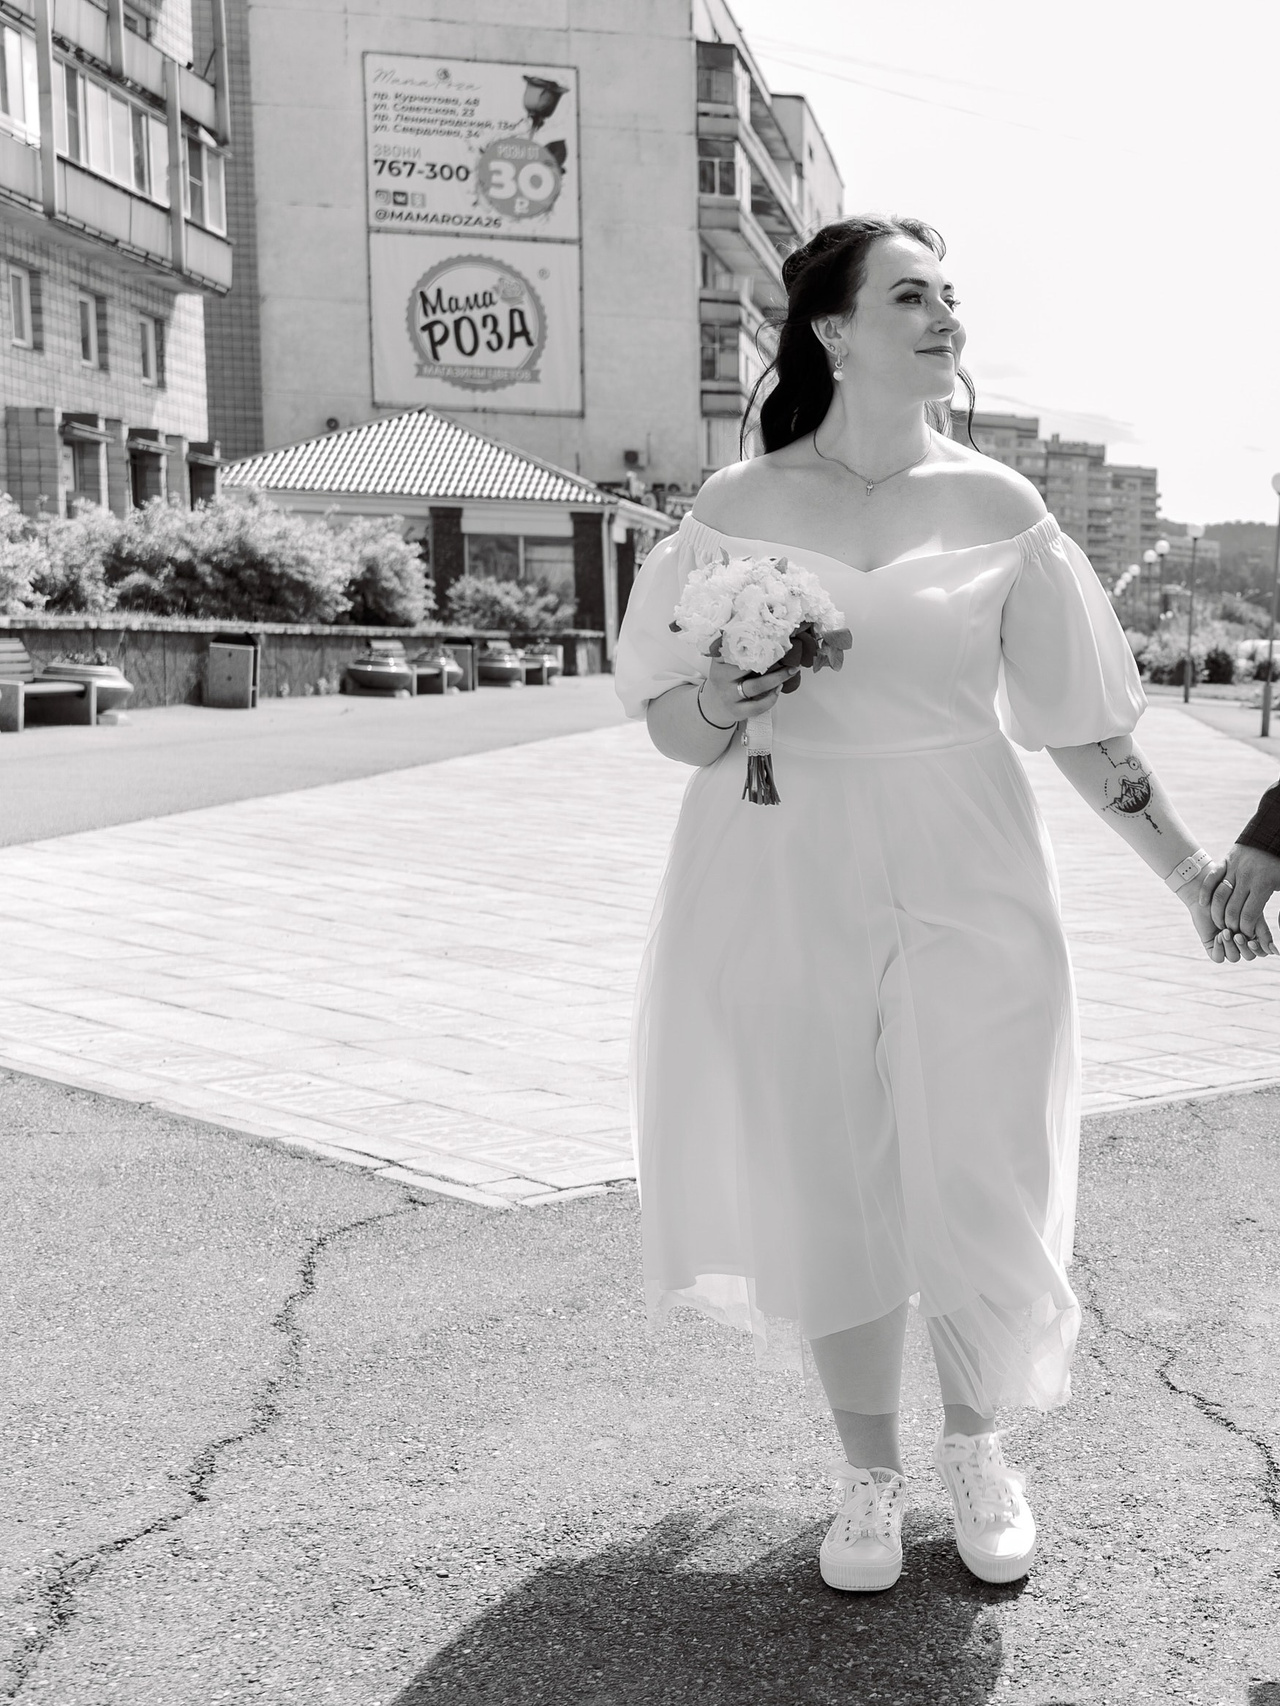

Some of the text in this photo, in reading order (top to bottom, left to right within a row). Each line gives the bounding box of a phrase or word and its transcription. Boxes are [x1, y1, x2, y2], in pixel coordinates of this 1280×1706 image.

[373, 143, 422, 160] ЗВОНИ
[373, 159, 470, 181] 767-300
[488, 160, 555, 201] 30
[375, 209, 503, 229] @MAMAROZA26
[419, 287, 498, 318] Мама
[420, 307, 535, 362] РОЗА
